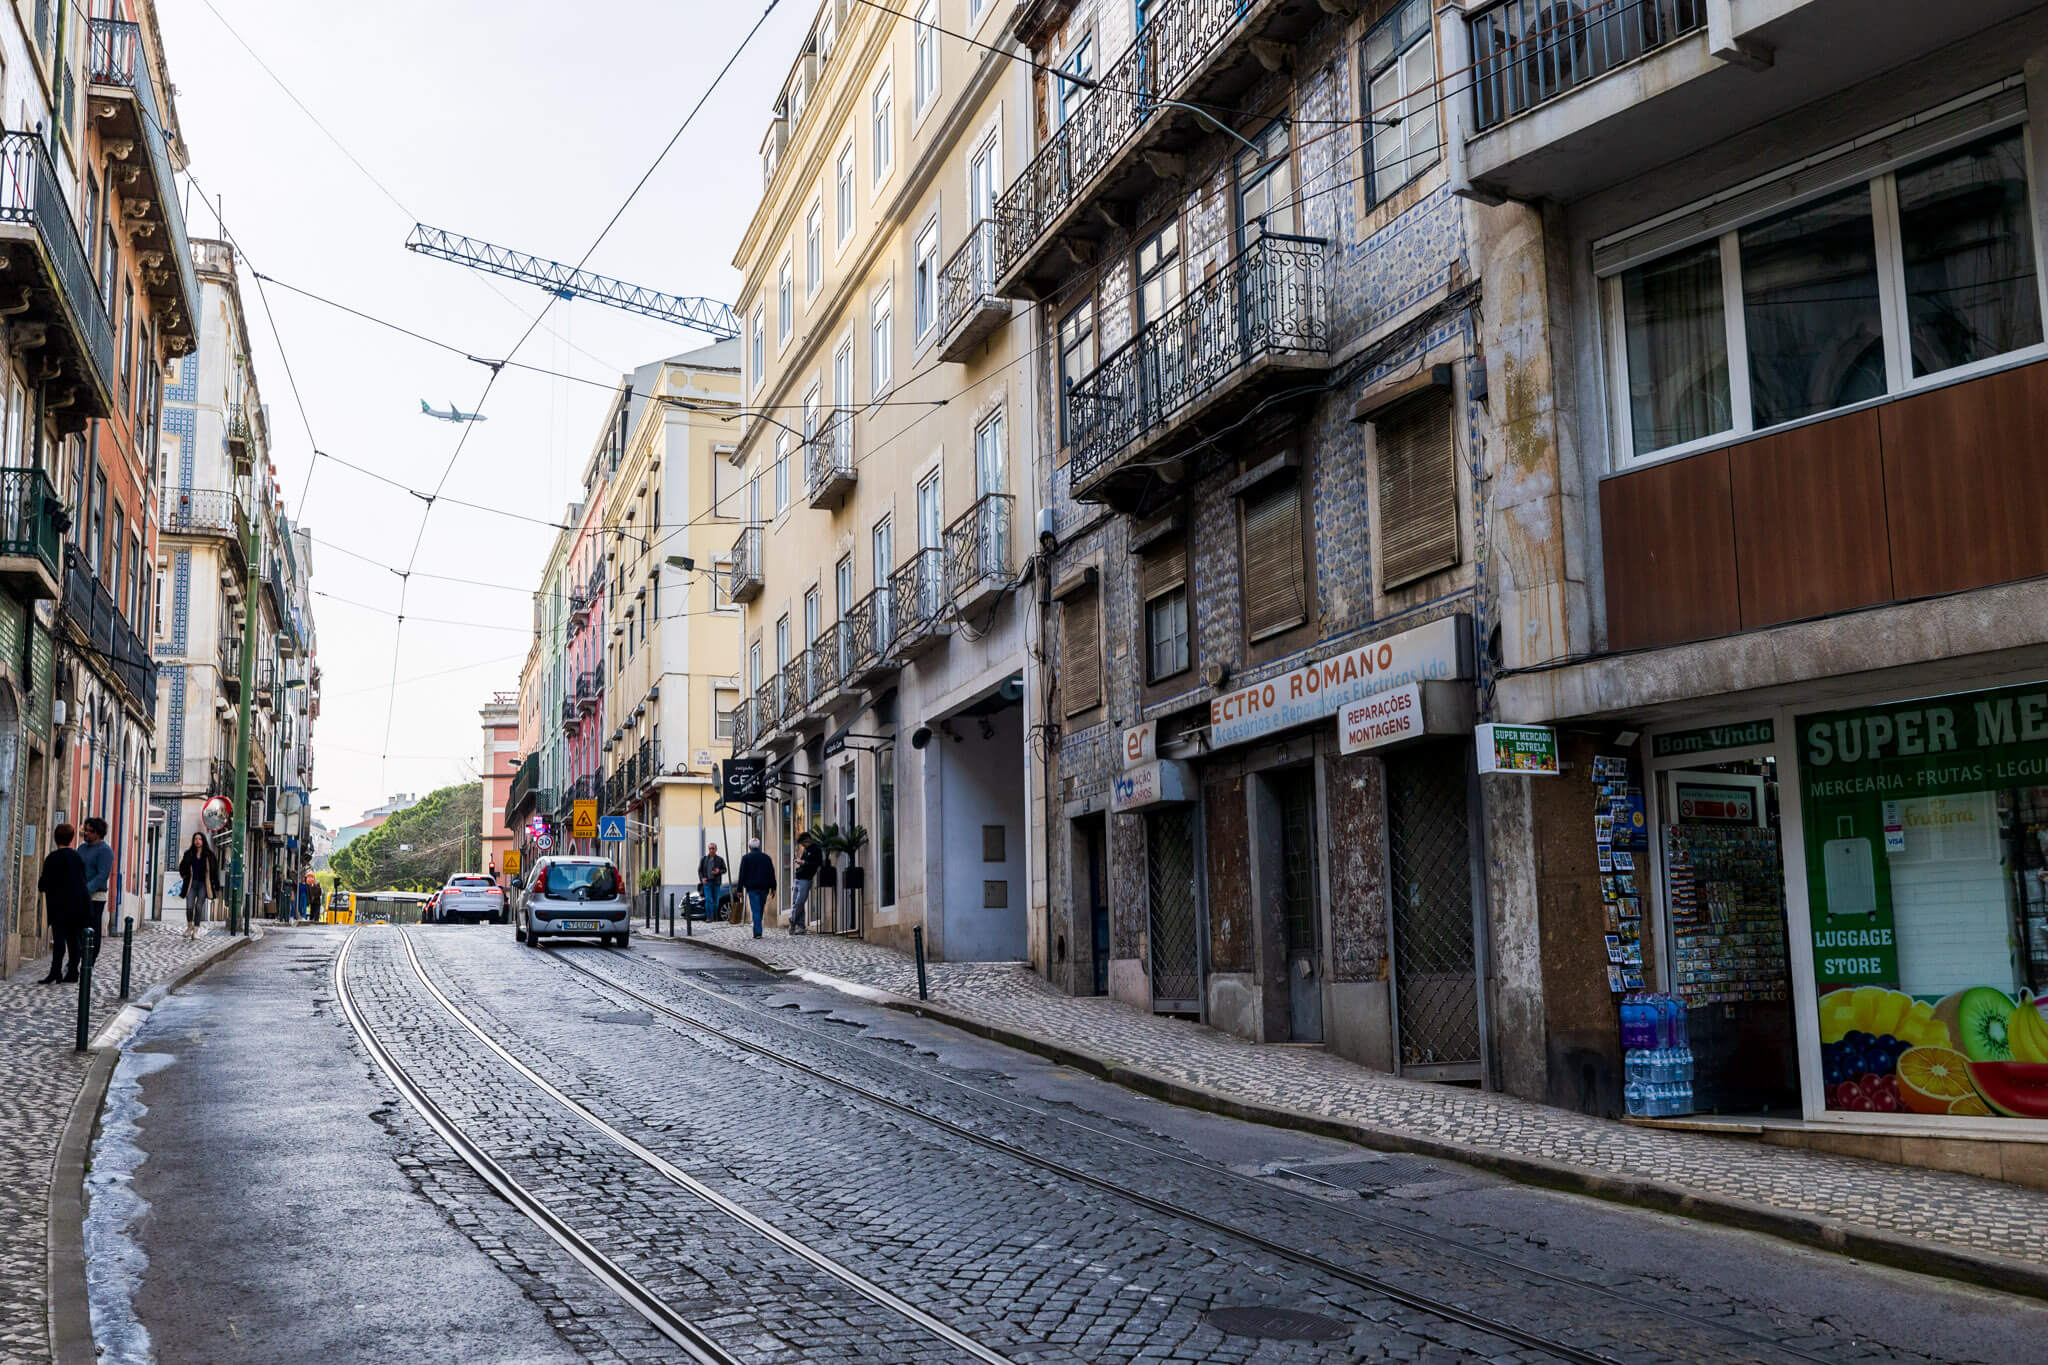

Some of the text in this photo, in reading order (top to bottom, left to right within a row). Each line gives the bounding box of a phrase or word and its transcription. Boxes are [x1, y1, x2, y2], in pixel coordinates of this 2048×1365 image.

[1290, 644, 1392, 699] ROMANO
[1348, 694, 1412, 726] REPARAÇÕES
[1349, 715, 1411, 745] MONTAGENS
[1495, 729, 1552, 742] SUPER MERCADO
[1709, 723, 1771, 746] Vindo
[1807, 707, 1959, 766] SUPER
[1516, 741, 1547, 752] ESTRELA
[1810, 758, 2048, 797] MERCEARIA FRUTAS LEGU
[539, 838, 551, 846] 30
[1815, 928, 1893, 948] LUGGAGE
[1824, 957, 1882, 975] STORE
